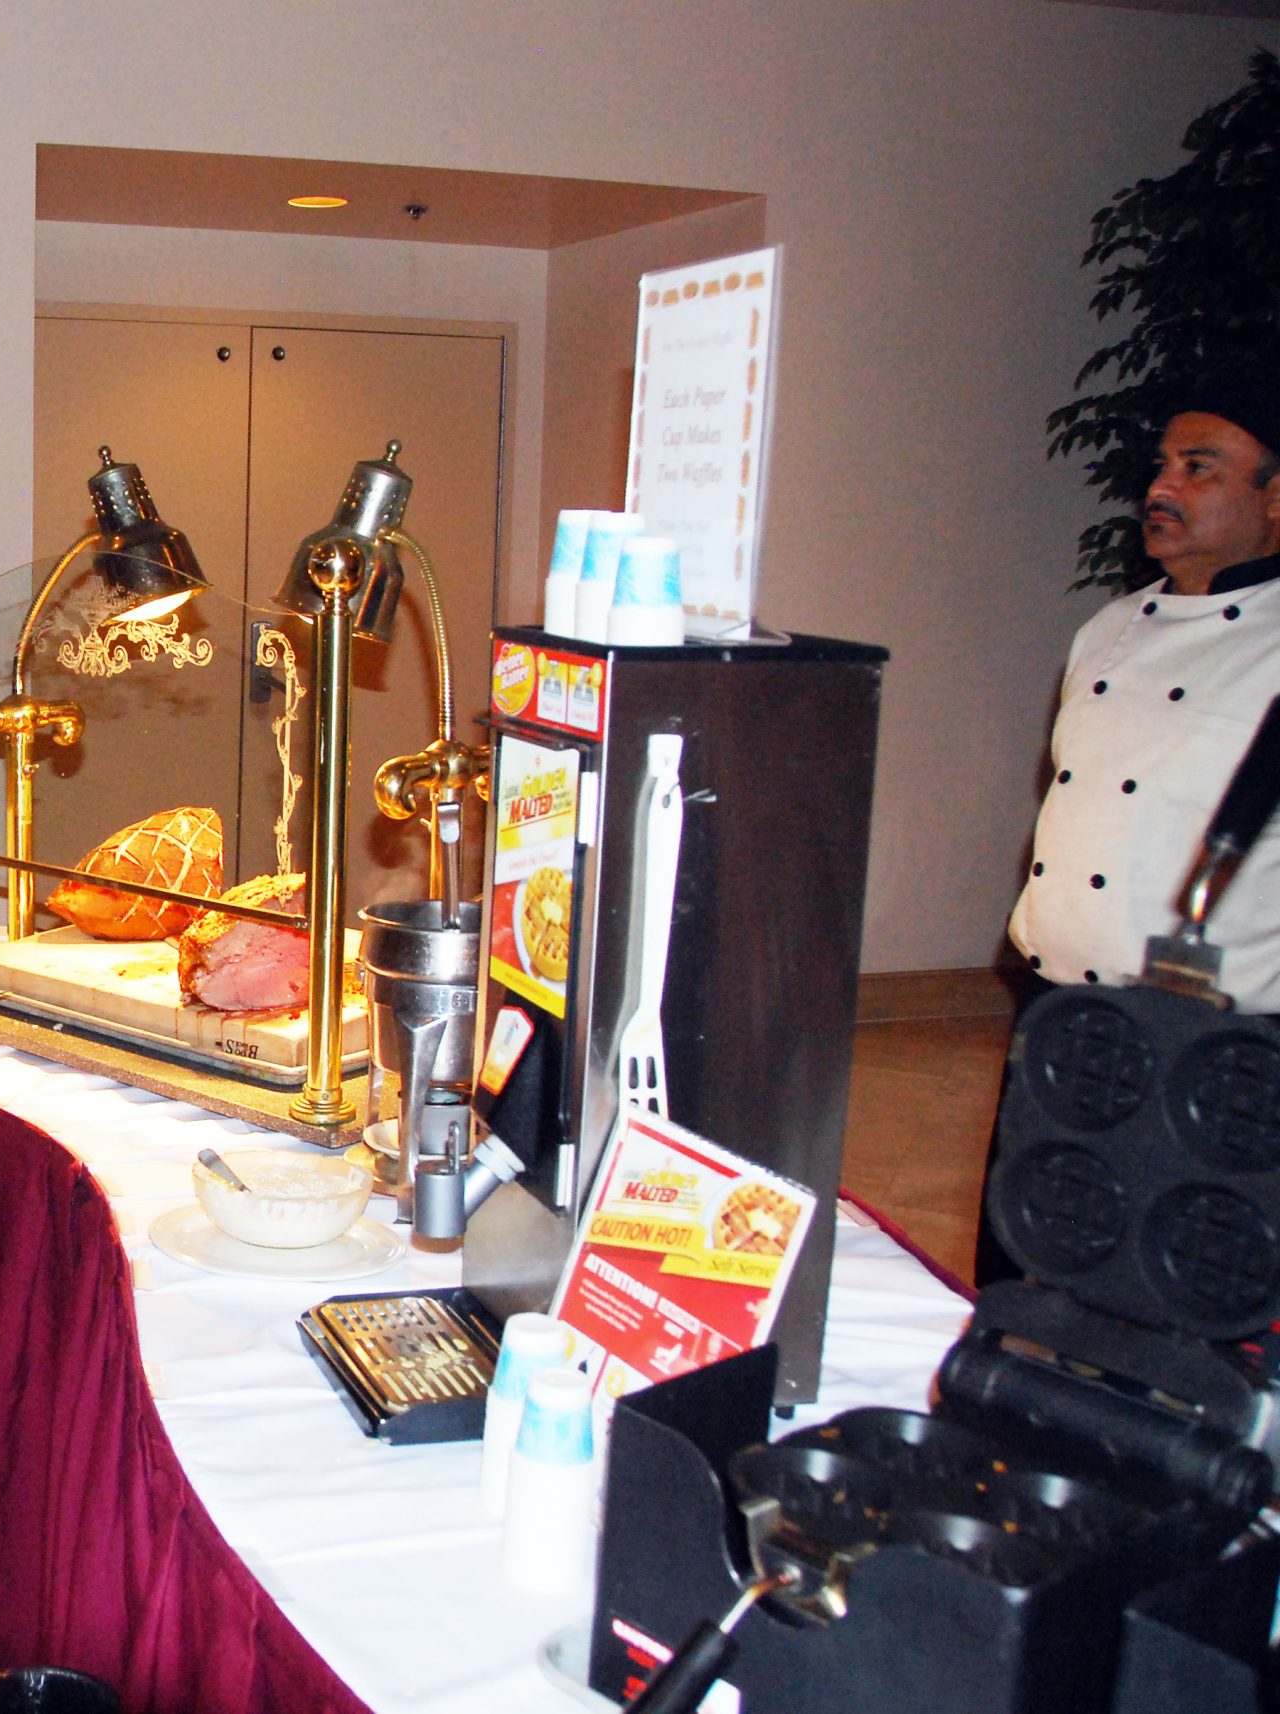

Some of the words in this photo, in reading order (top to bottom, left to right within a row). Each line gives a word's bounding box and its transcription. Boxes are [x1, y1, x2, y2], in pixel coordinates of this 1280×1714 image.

[663, 388, 690, 408] Each
[693, 386, 726, 410] Paper
[662, 425, 683, 450] Cup
[687, 423, 721, 444] Makes
[657, 463, 679, 482] Two
[683, 462, 722, 488] Waffles
[509, 793, 554, 825] MALTED
[624, 1181, 678, 1202] MALTED
[591, 1218, 653, 1242] CAUTION
[654, 1225, 693, 1248] HOT!
